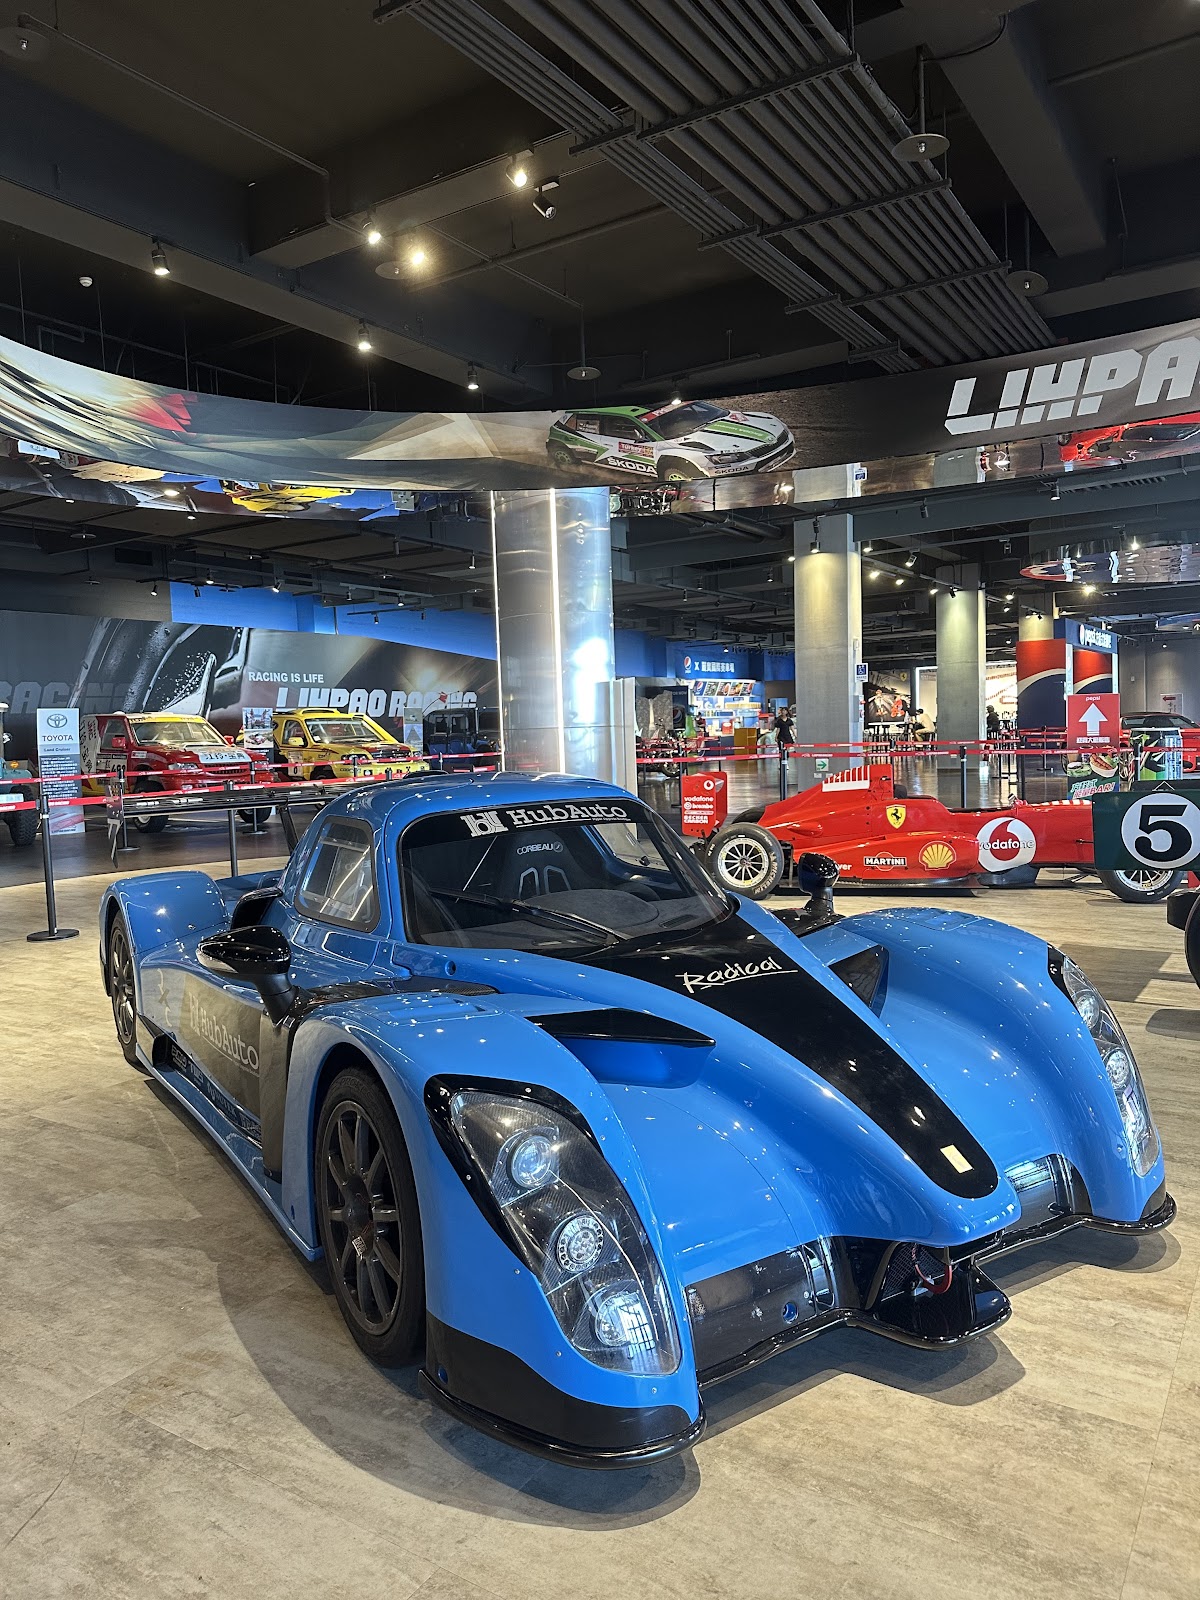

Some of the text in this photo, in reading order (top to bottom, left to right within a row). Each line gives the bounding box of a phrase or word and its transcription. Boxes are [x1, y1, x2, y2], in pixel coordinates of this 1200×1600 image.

[945, 337, 1200, 435] LIHPA
[248, 671, 324, 684] RACING IS LIFE
[388, 690, 478, 718] RACNG
[42, 734, 74, 742] TOYOTA
[683, 795, 714, 803] vodafone
[505, 803, 628, 826] HubAuto
[1134, 804, 1193, 863] 5
[516, 843, 554, 856] CORBEAU
[839, 863, 852, 871] ver
[865, 858, 905, 866] MARTINI
[675, 956, 784, 994] Radical
[200, 1006, 259, 1071] HubAuto
